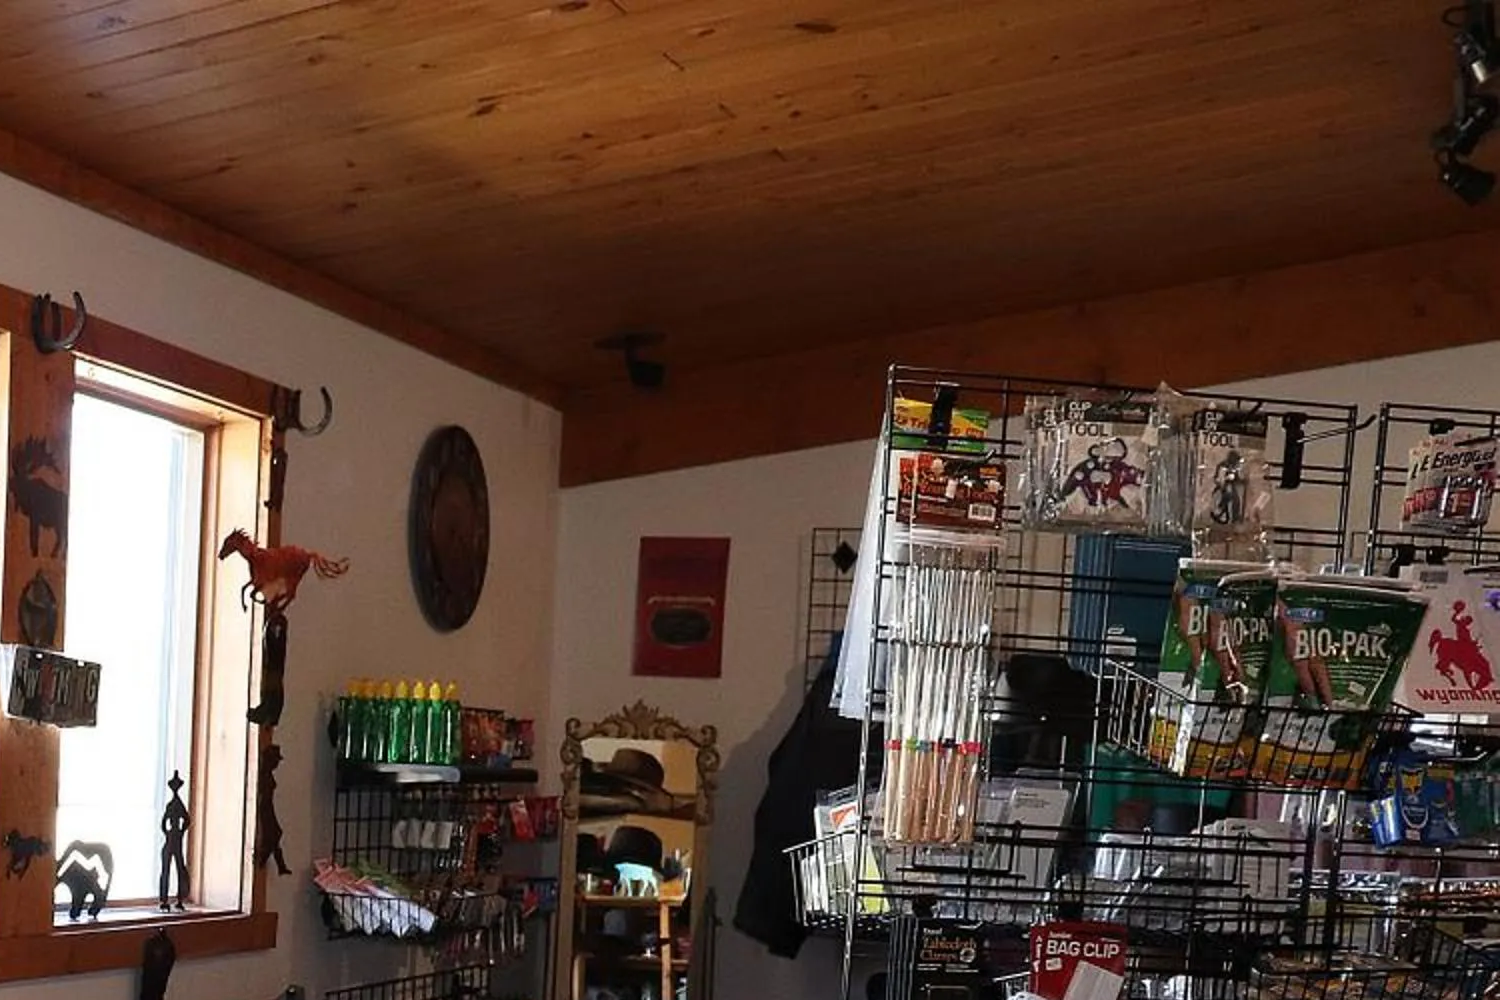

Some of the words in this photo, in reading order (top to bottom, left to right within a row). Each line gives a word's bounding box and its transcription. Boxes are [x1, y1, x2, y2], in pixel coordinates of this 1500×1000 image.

[1069, 423, 1109, 436] TOOL
[1218, 616, 1271, 651] BIO-PA
[1046, 940, 1080, 957] BAG
[1083, 942, 1120, 959] CLIP
